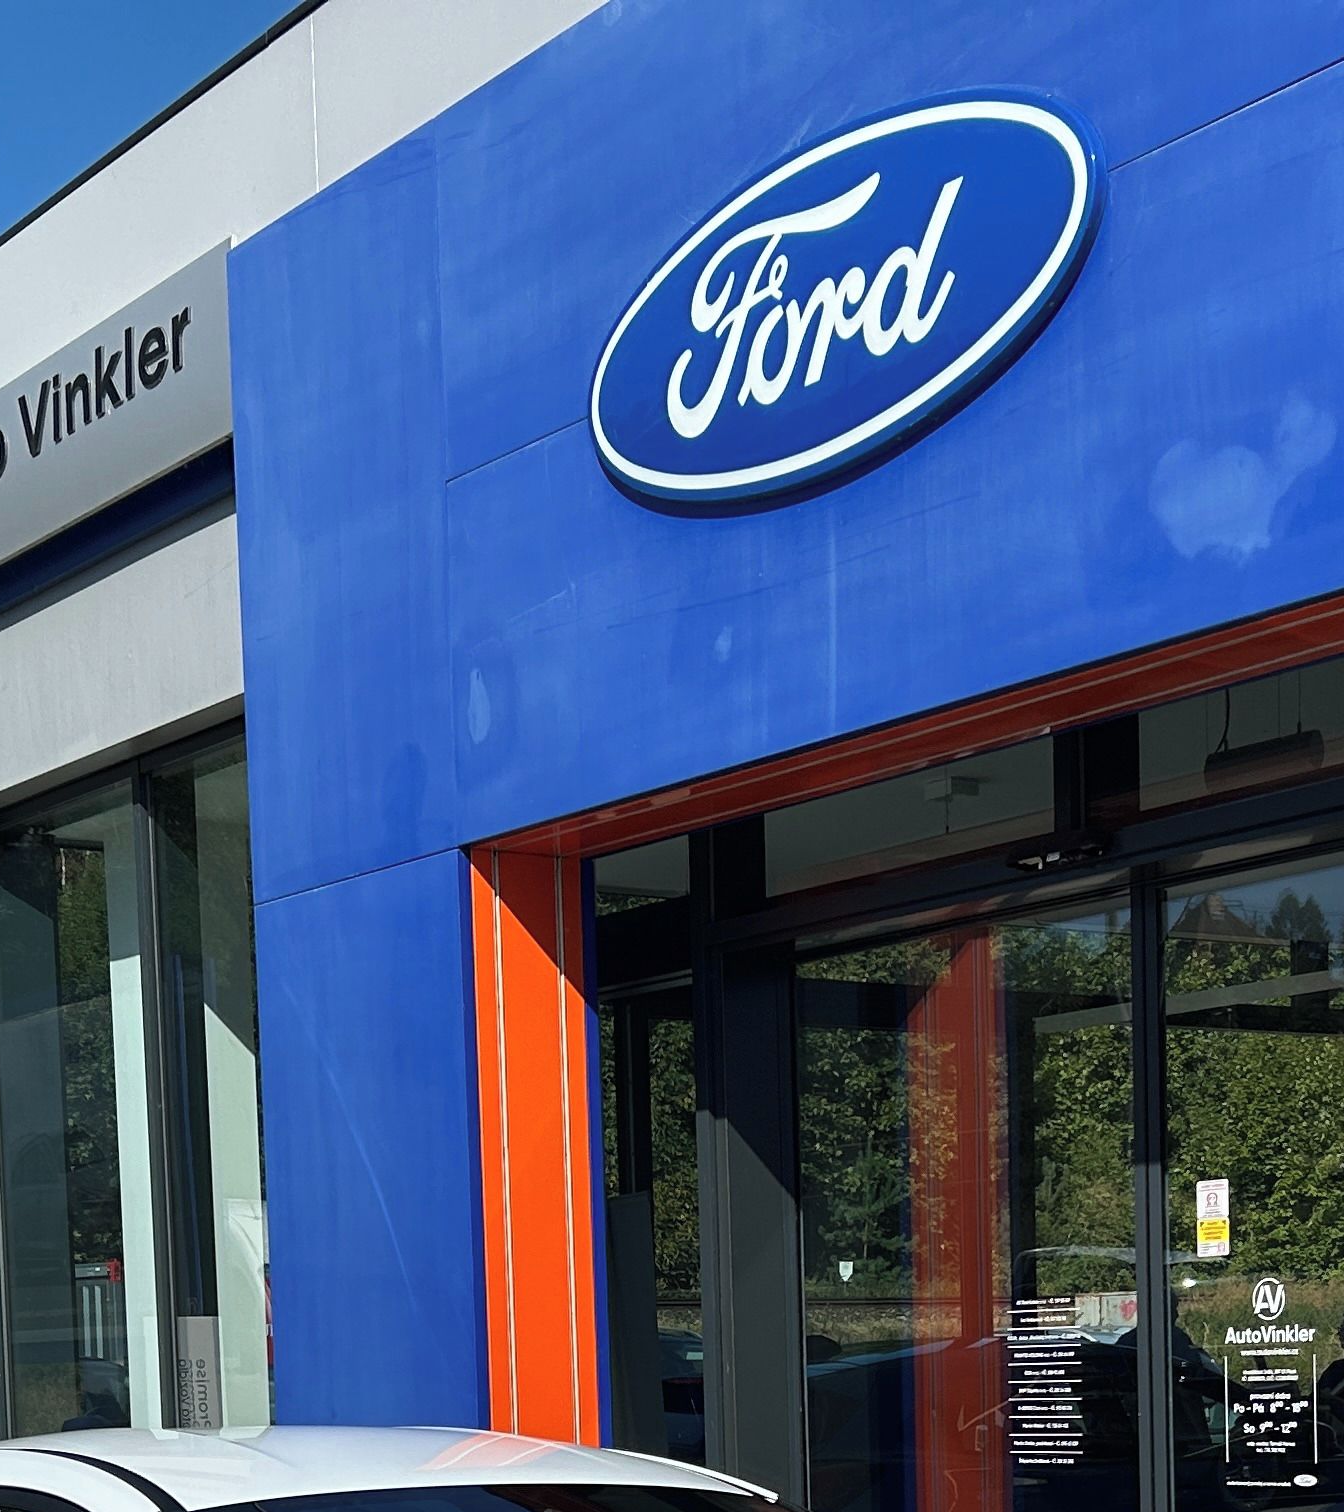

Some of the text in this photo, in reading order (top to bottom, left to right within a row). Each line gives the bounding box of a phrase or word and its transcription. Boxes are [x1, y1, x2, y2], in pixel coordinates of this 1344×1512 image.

[666, 171, 964, 438] Ford
[17, 305, 192, 459] Vinkler
[1224, 1324, 1316, 1345] AutoVinkler
[1243, 1422, 1256, 1433] So
